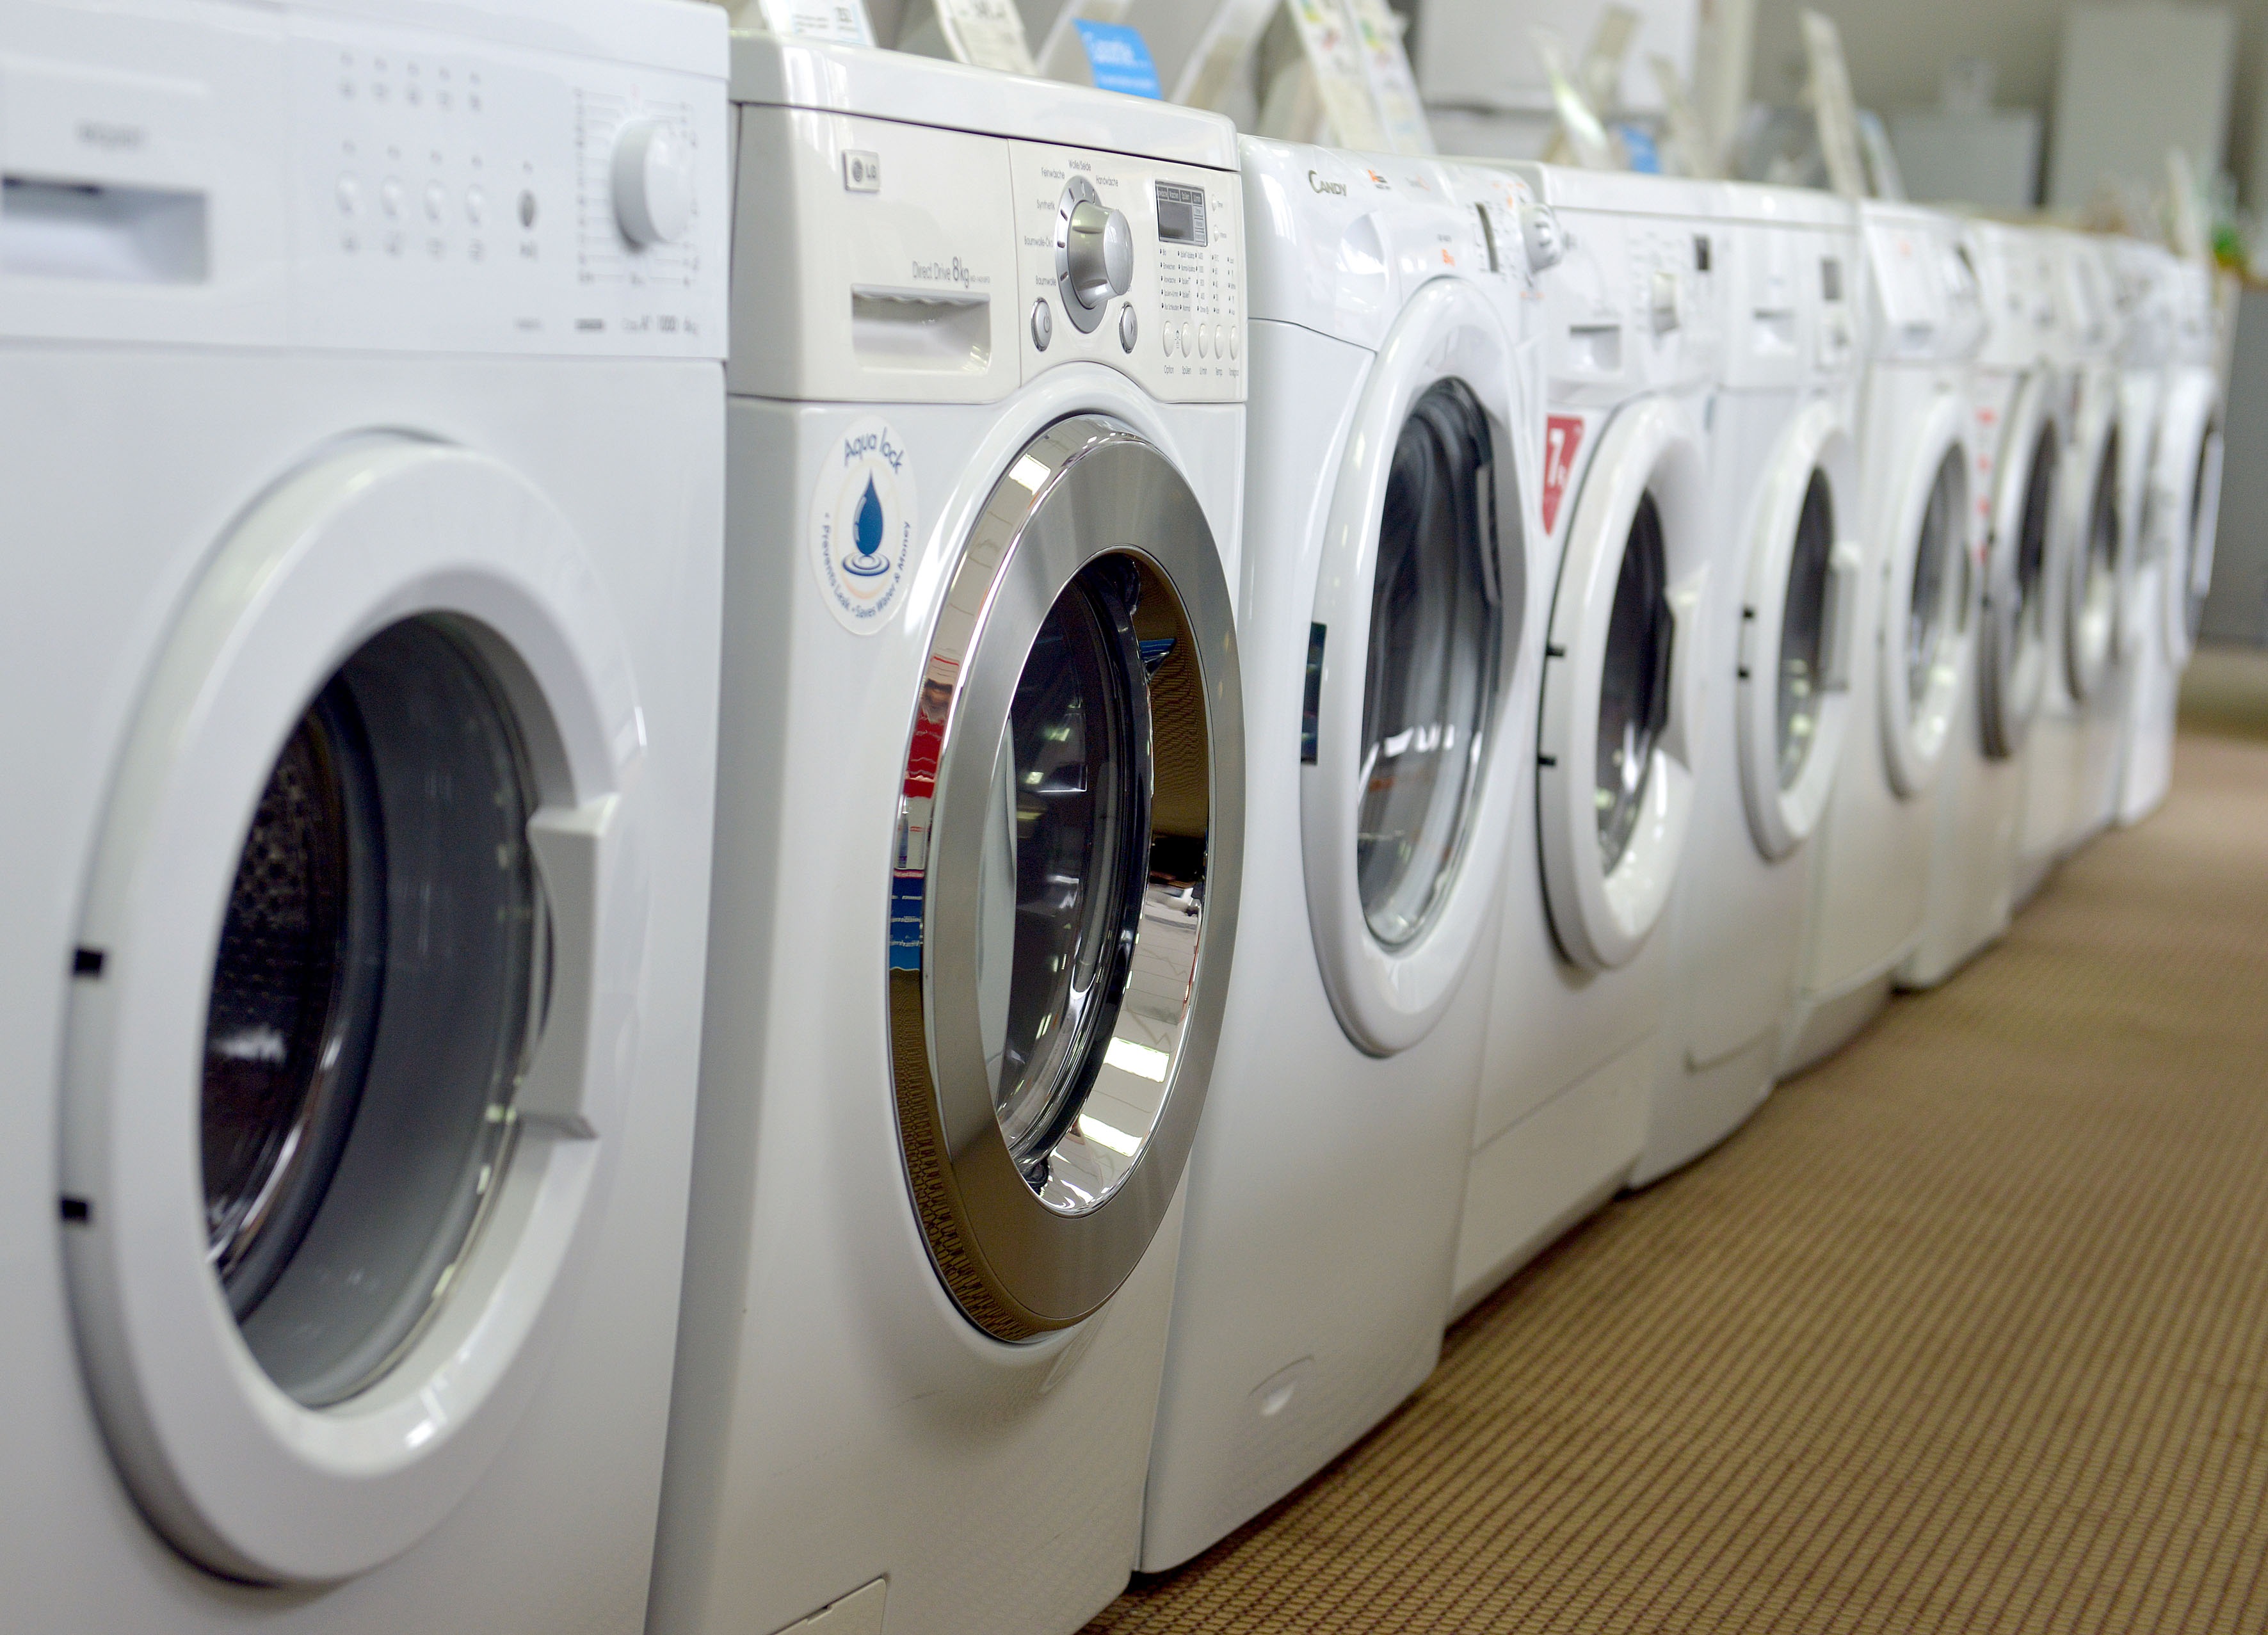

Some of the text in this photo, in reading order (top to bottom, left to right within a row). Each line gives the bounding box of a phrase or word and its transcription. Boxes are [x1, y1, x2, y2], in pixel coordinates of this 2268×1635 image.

[865, 163, 876, 179] LG
[1068, 160, 1091, 172] Wolle/Seide
[1041, 167, 1065, 179] Feinwäsche
[1096, 175, 1119, 187] Handwäsche
[1036, 199, 1056, 211] Synthetik
[1024, 236, 1053, 248] Baumwolle-Öko
[912, 261, 933, 279] Direct
[934, 262, 951, 280] Drive
[953, 256, 969, 288] 8kg
[1036, 275, 1057, 286] Baumwolle
[1164, 365, 1174, 375] Option
[1182, 366, 1191, 376] Spülen
[844, 433, 878, 467] Aqua
[822, 524, 835, 587] Prevents
[834, 584, 850, 611] Leak
[897, 520, 911, 571] Money
